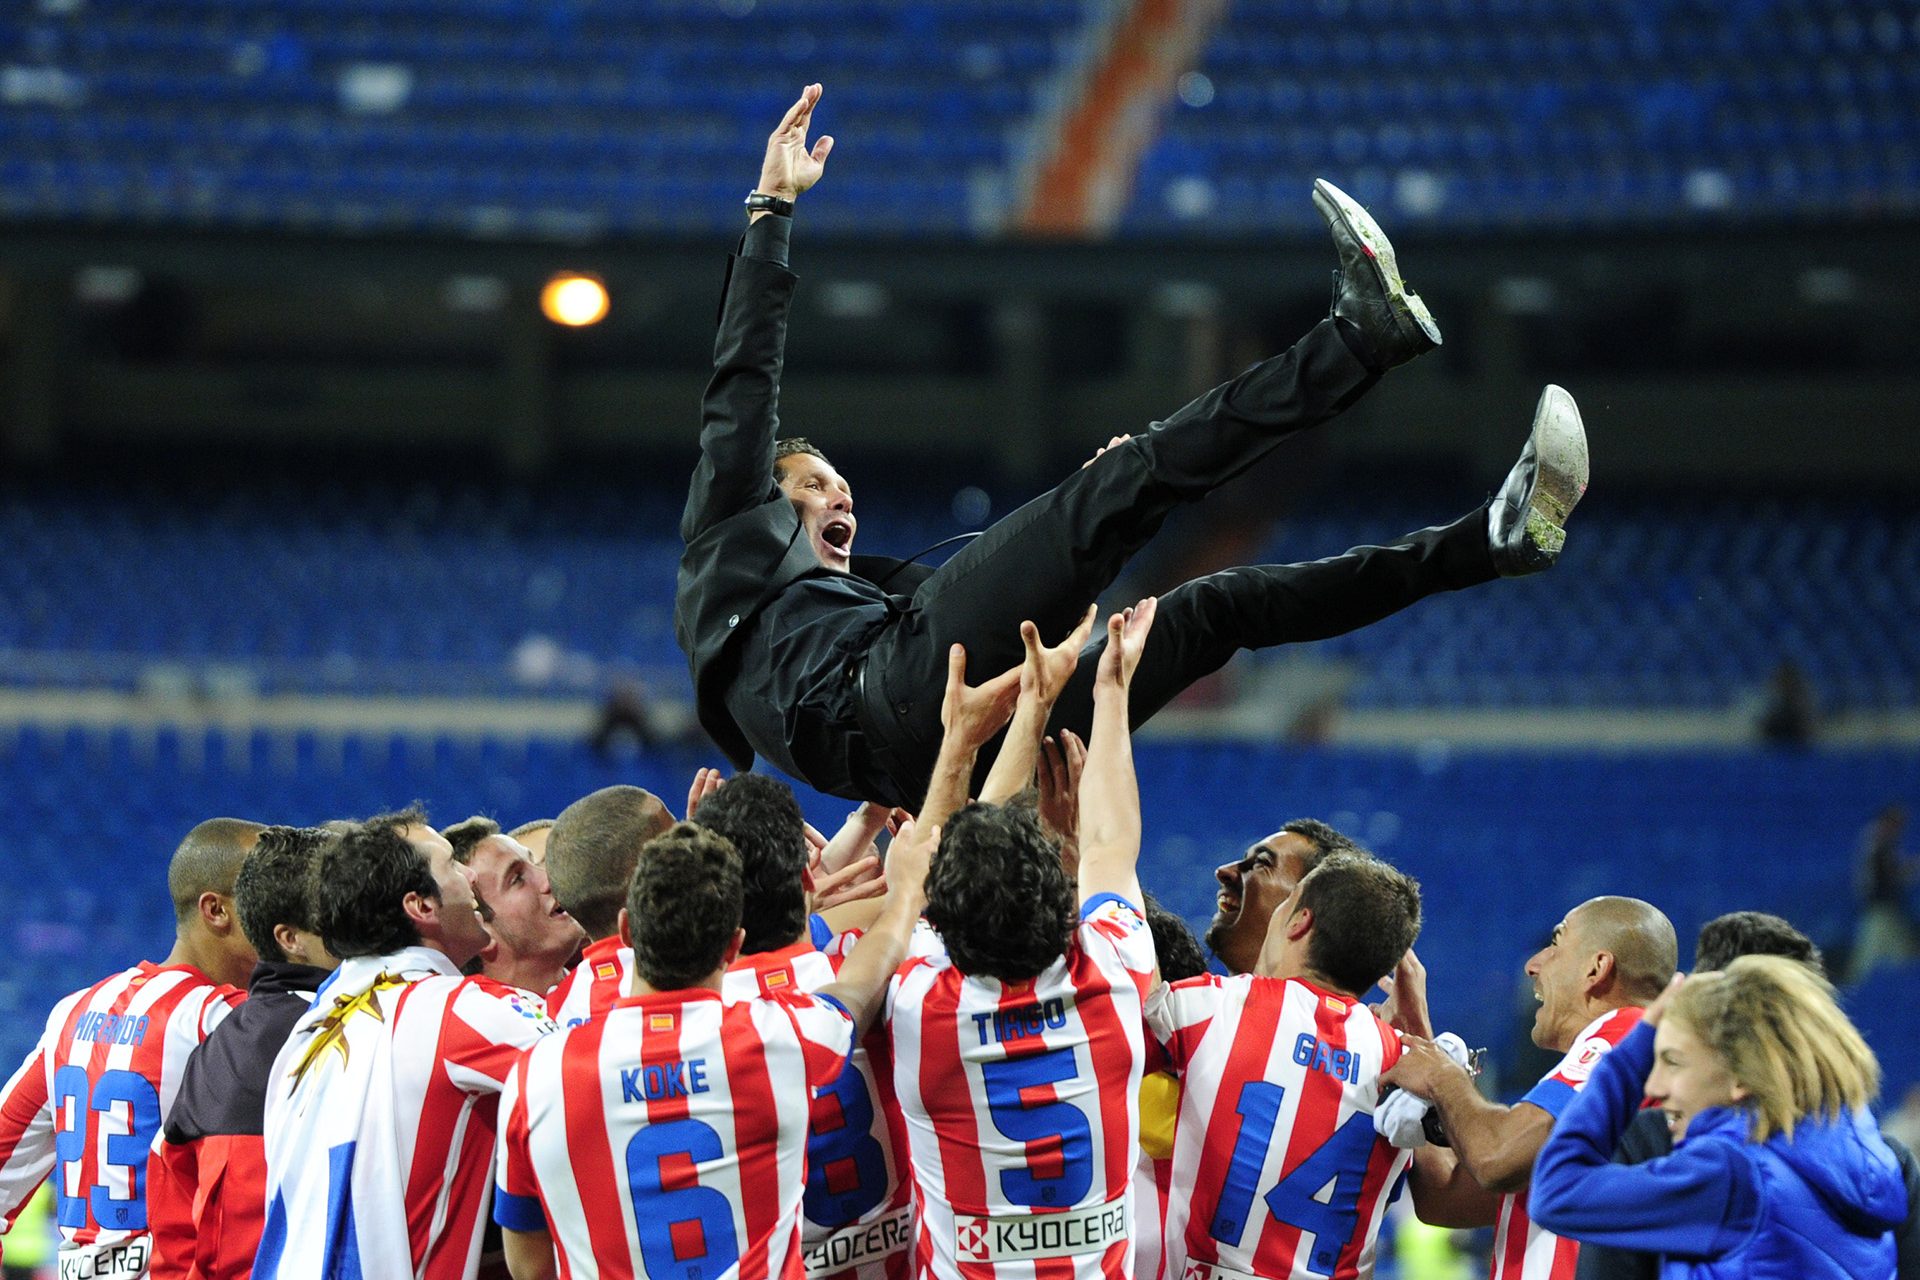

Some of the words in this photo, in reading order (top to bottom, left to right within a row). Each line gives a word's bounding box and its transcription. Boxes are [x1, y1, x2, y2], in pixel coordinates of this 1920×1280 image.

[72, 1010, 150, 1046] MIRANDA
[972, 997, 1067, 1046] TIAGO
[621, 1058, 710, 1104] KOKE
[1293, 1036, 1361, 1085] GABI
[55, 1065, 162, 1230] 23
[982, 1046, 1094, 1208] 5
[626, 1118, 740, 1280] 6
[1208, 1080, 1378, 1277] 14
[997, 1204, 1125, 1253] KYOCERA
